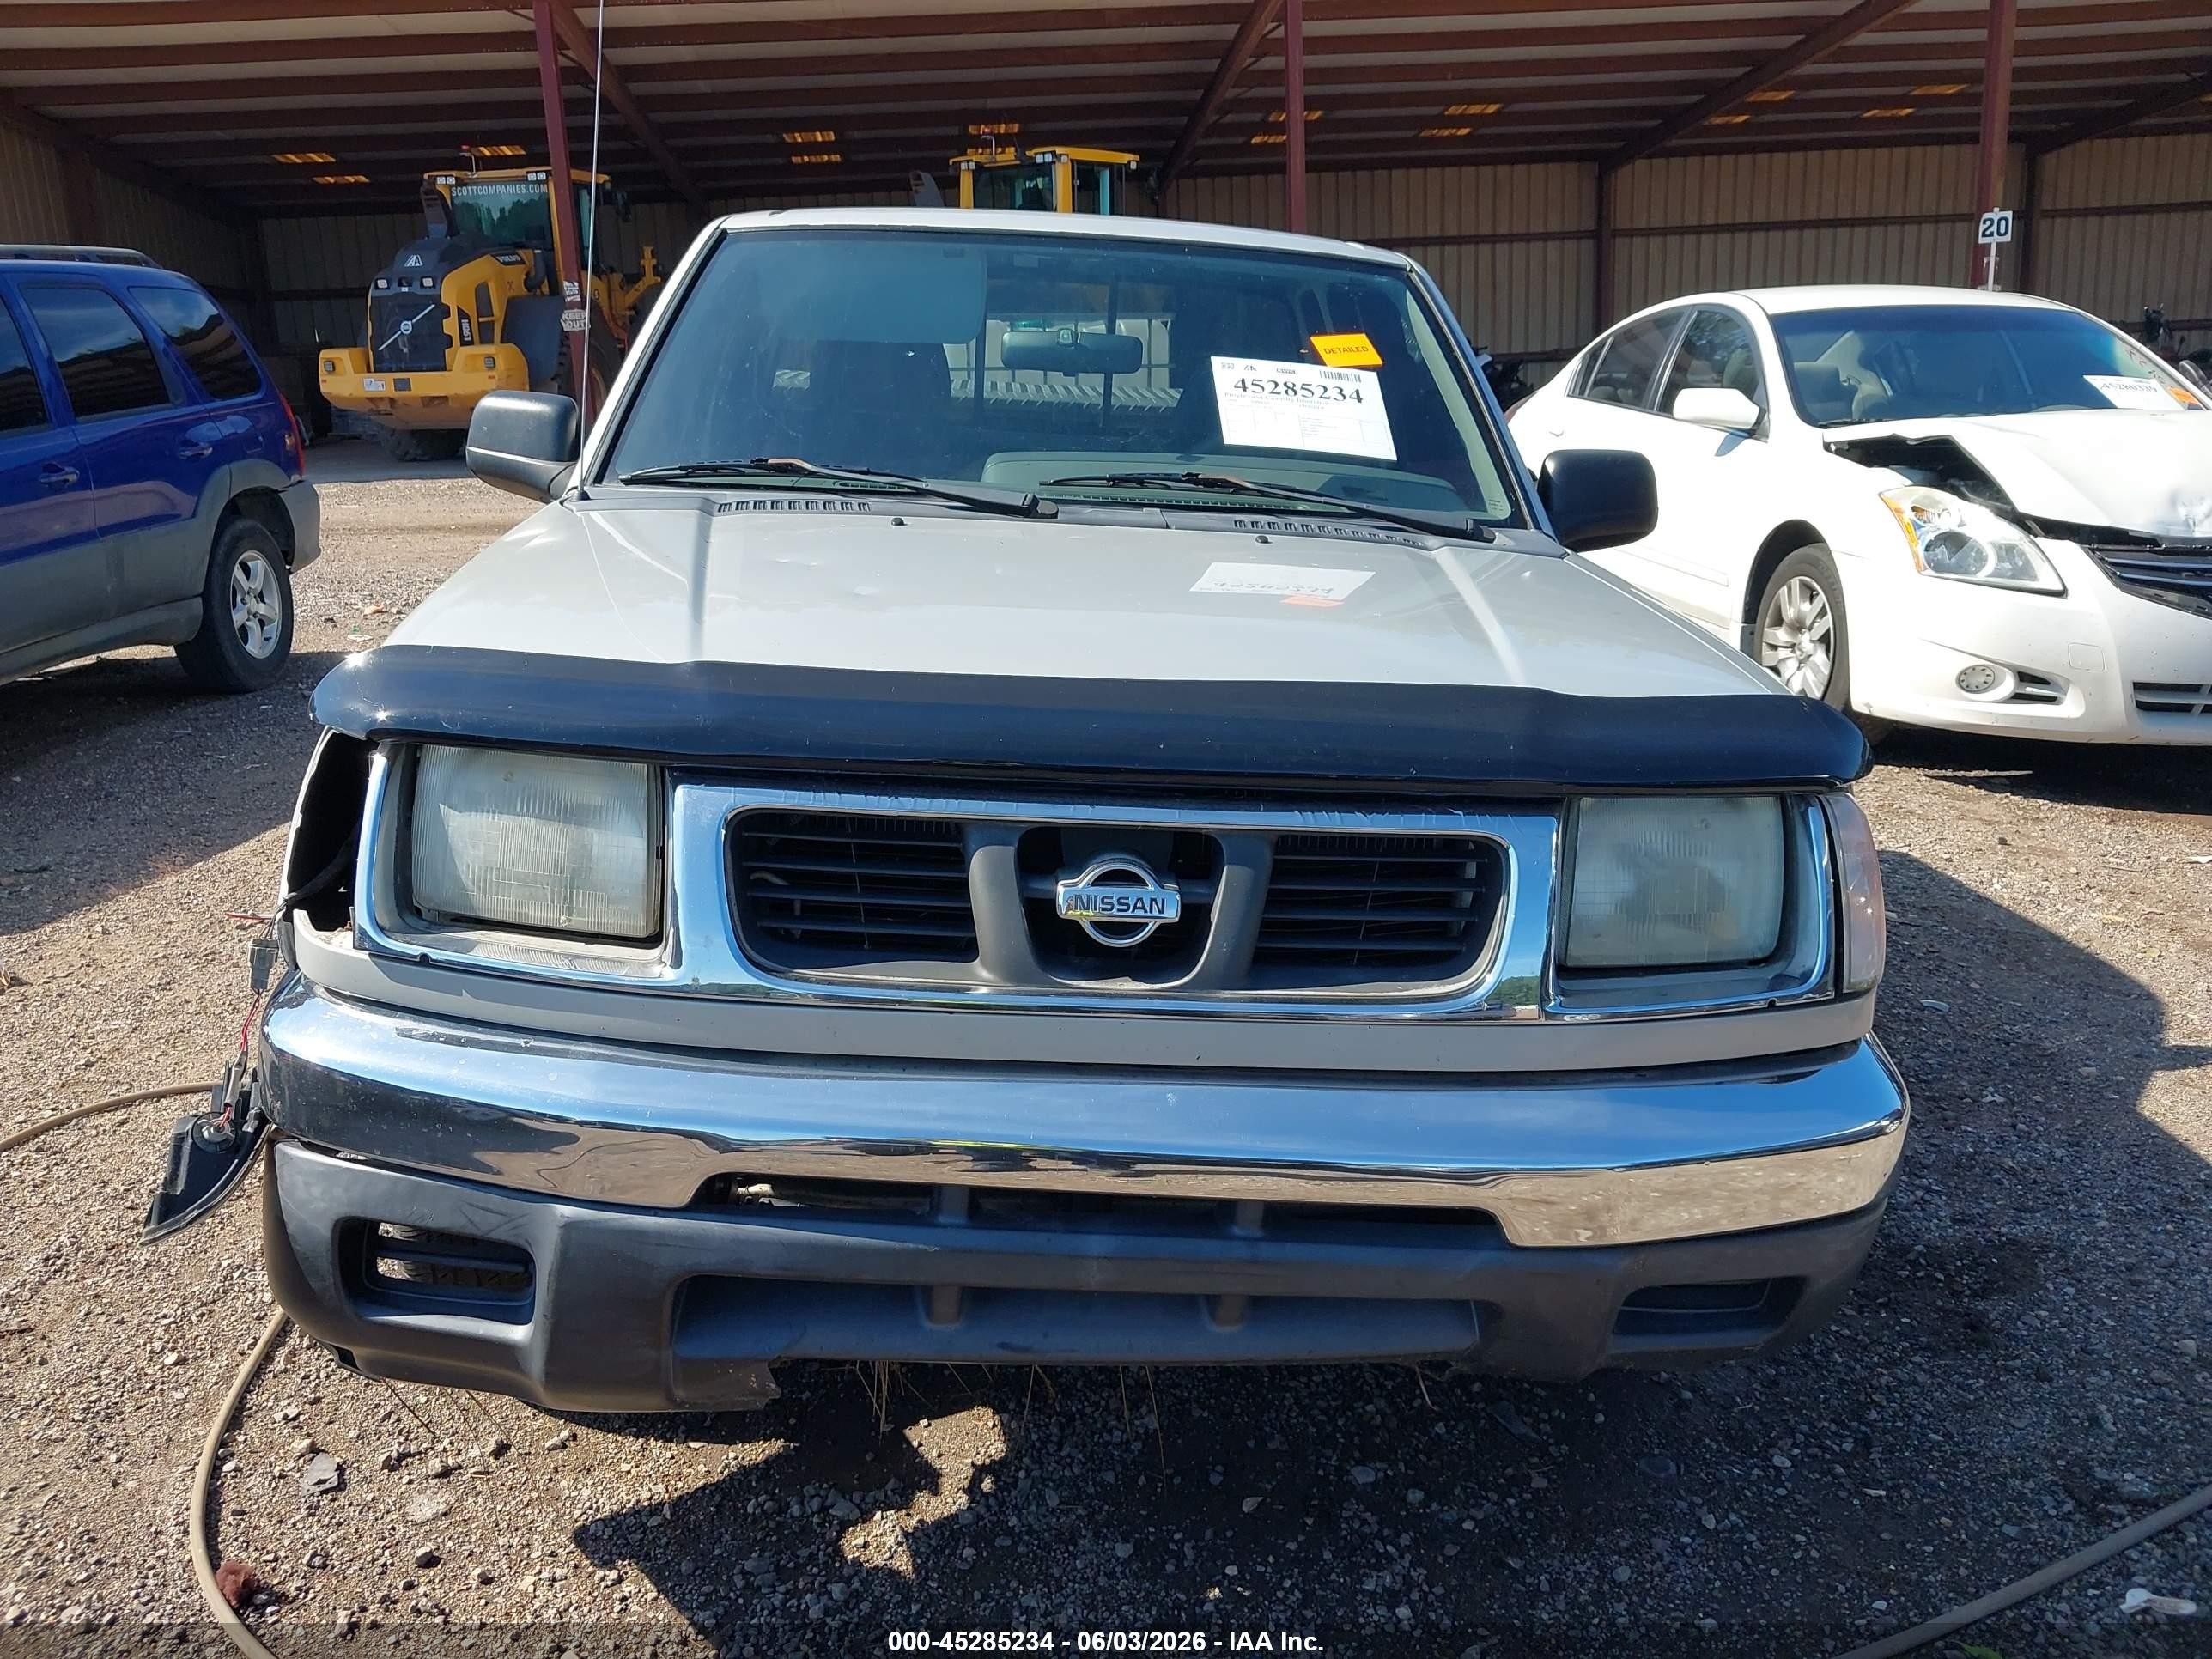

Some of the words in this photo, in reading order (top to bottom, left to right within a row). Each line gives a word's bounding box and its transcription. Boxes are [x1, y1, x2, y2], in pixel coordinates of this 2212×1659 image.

[451, 183, 549, 197] SCOTTCOMPANIES.COM
[1980, 216, 2010, 239] 20
[1323, 345, 1369, 356] DETAILED
[1232, 377, 1364, 404] 45285234
[1073, 893, 1165, 915] NISSAN
